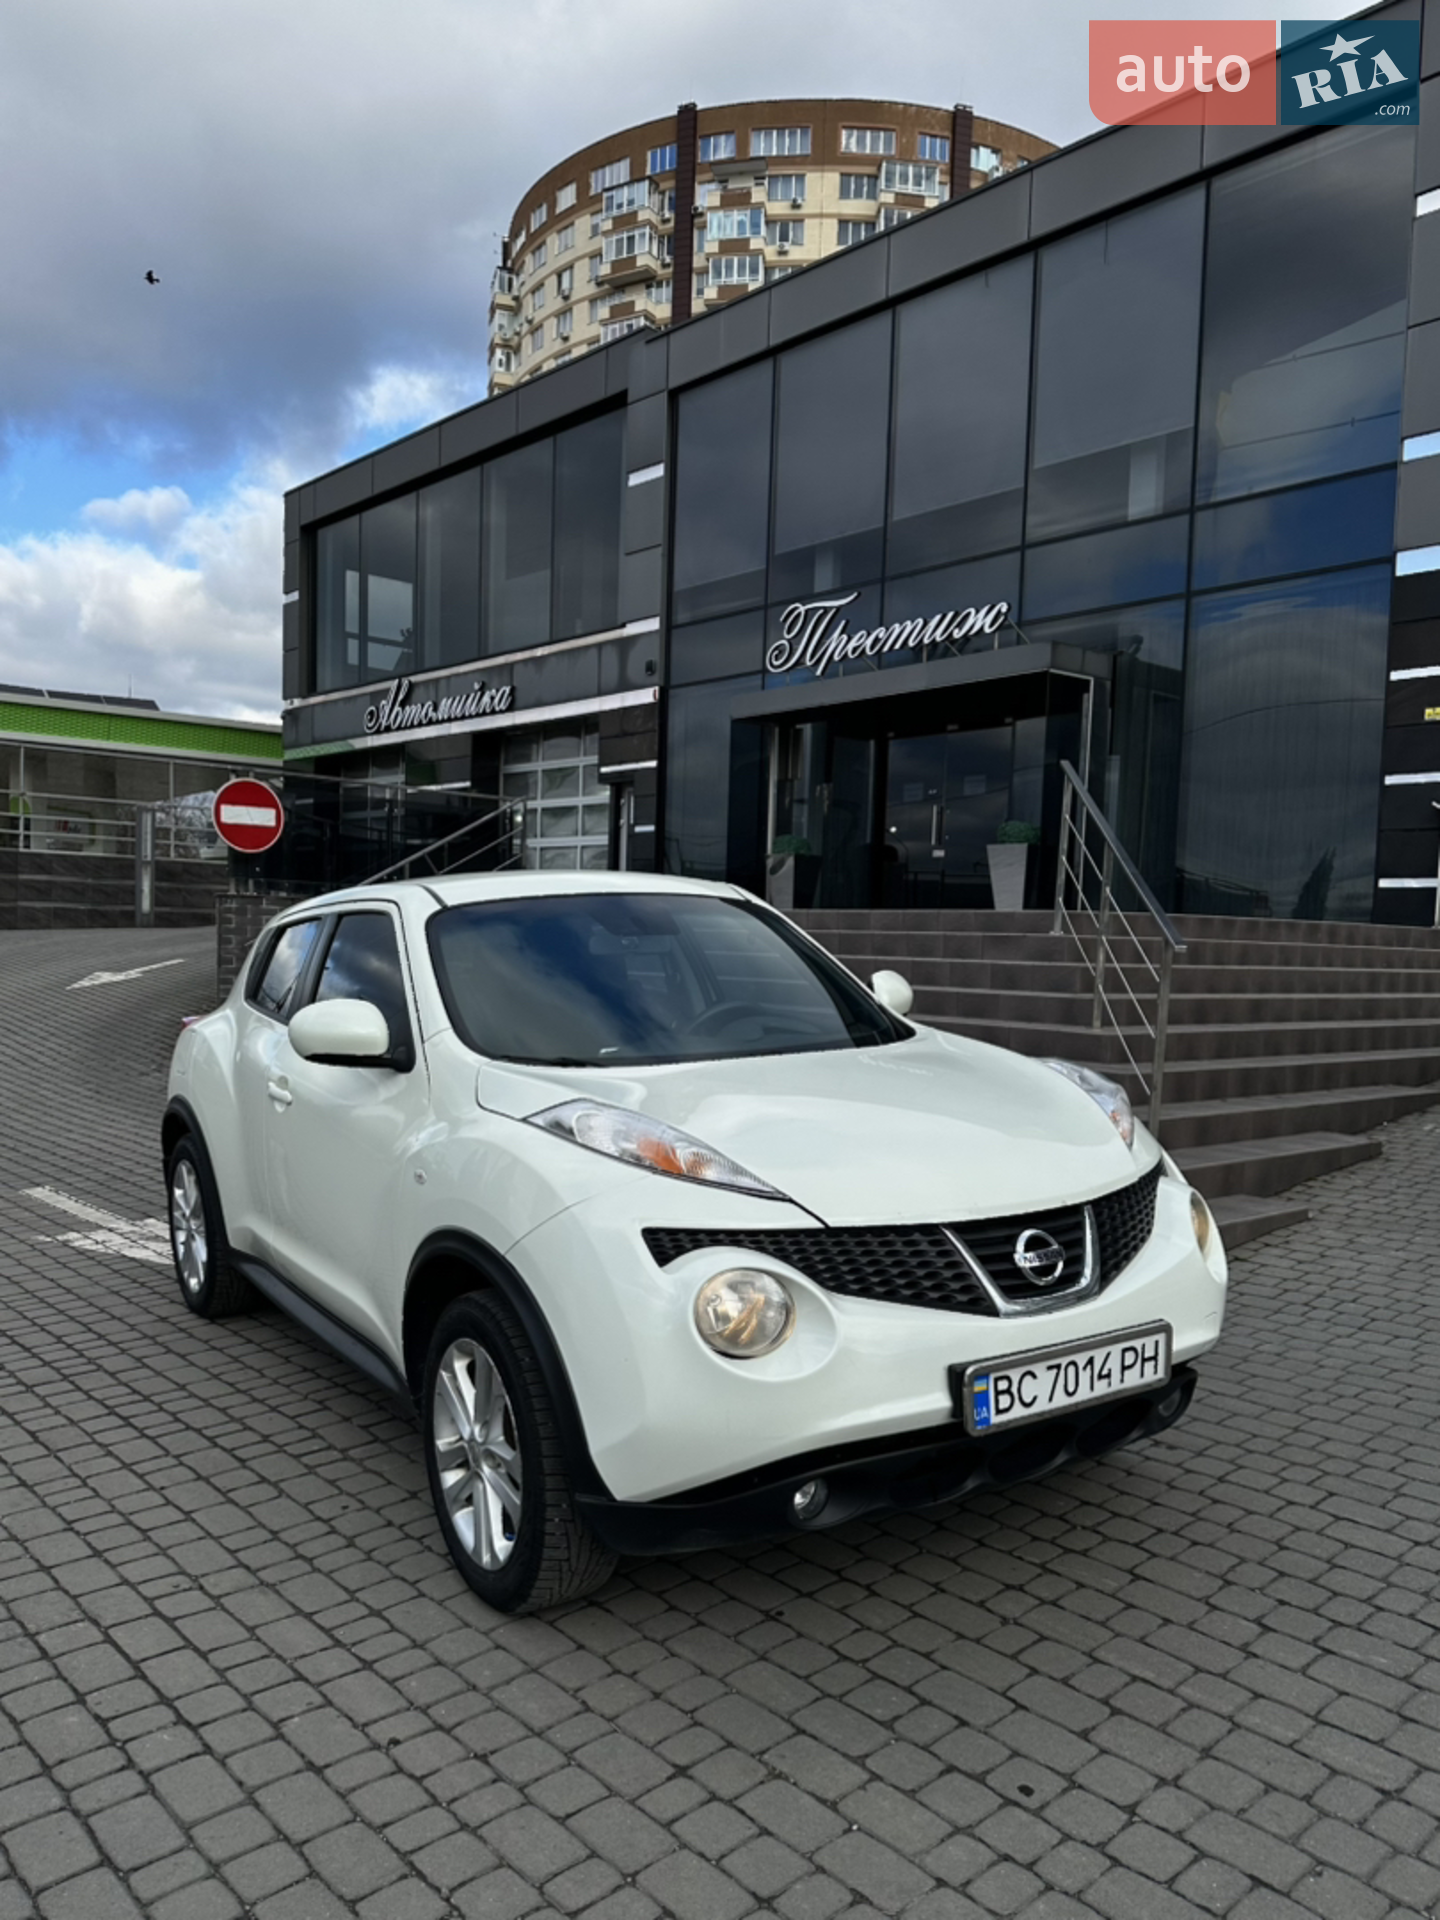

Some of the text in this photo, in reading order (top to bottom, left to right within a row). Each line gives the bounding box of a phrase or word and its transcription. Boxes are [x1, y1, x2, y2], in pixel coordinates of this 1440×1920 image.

[766, 592, 1008, 677] Престиж
[364, 679, 513, 733] Автомийка
[993, 1340, 1159, 1416] BC 7014 PH
[974, 1406, 989, 1421] UA
